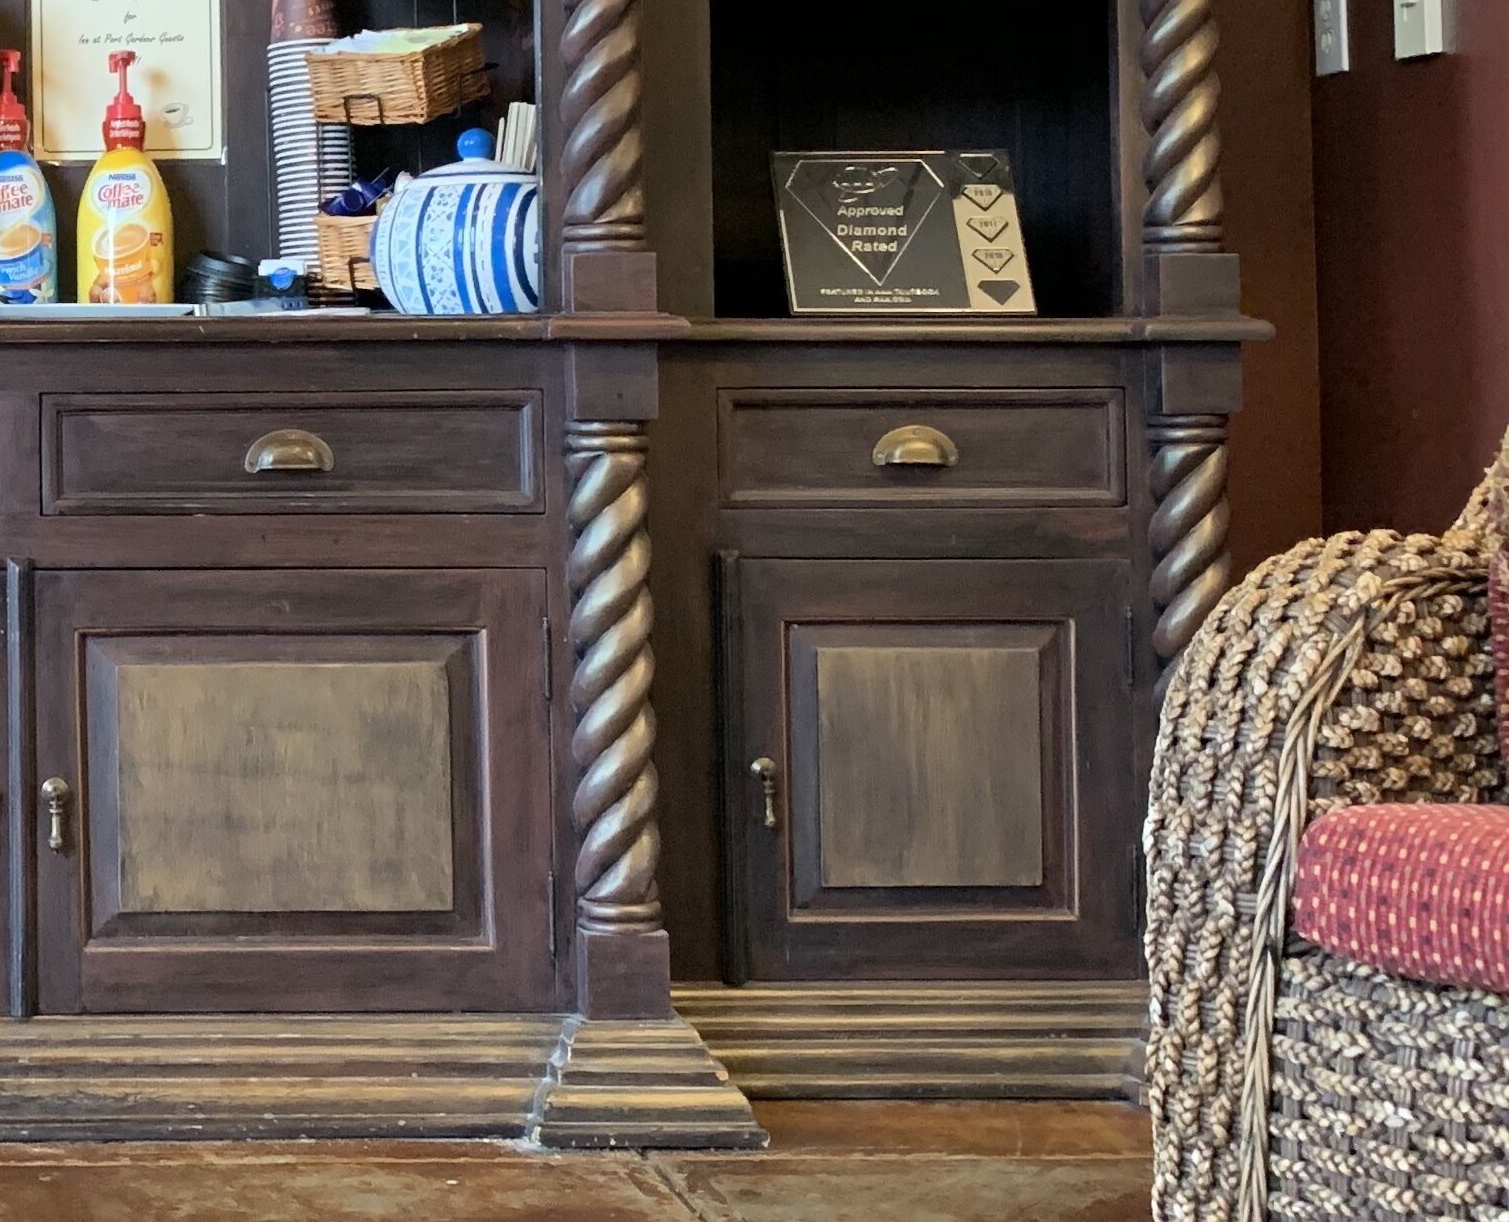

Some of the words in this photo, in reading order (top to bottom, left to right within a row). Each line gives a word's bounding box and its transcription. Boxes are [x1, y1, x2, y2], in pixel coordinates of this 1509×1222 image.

[124, 10, 137, 24] for
[78, 34, 89, 44] Inn
[92, 36, 101, 44] at
[105, 34, 123, 43] Port
[98, 182, 140, 202] Coffee
[107, 194, 144, 210] mate
[837, 205, 904, 218] Approved
[837, 224, 908, 236] Diamond
[852, 240, 898, 252] Rated
